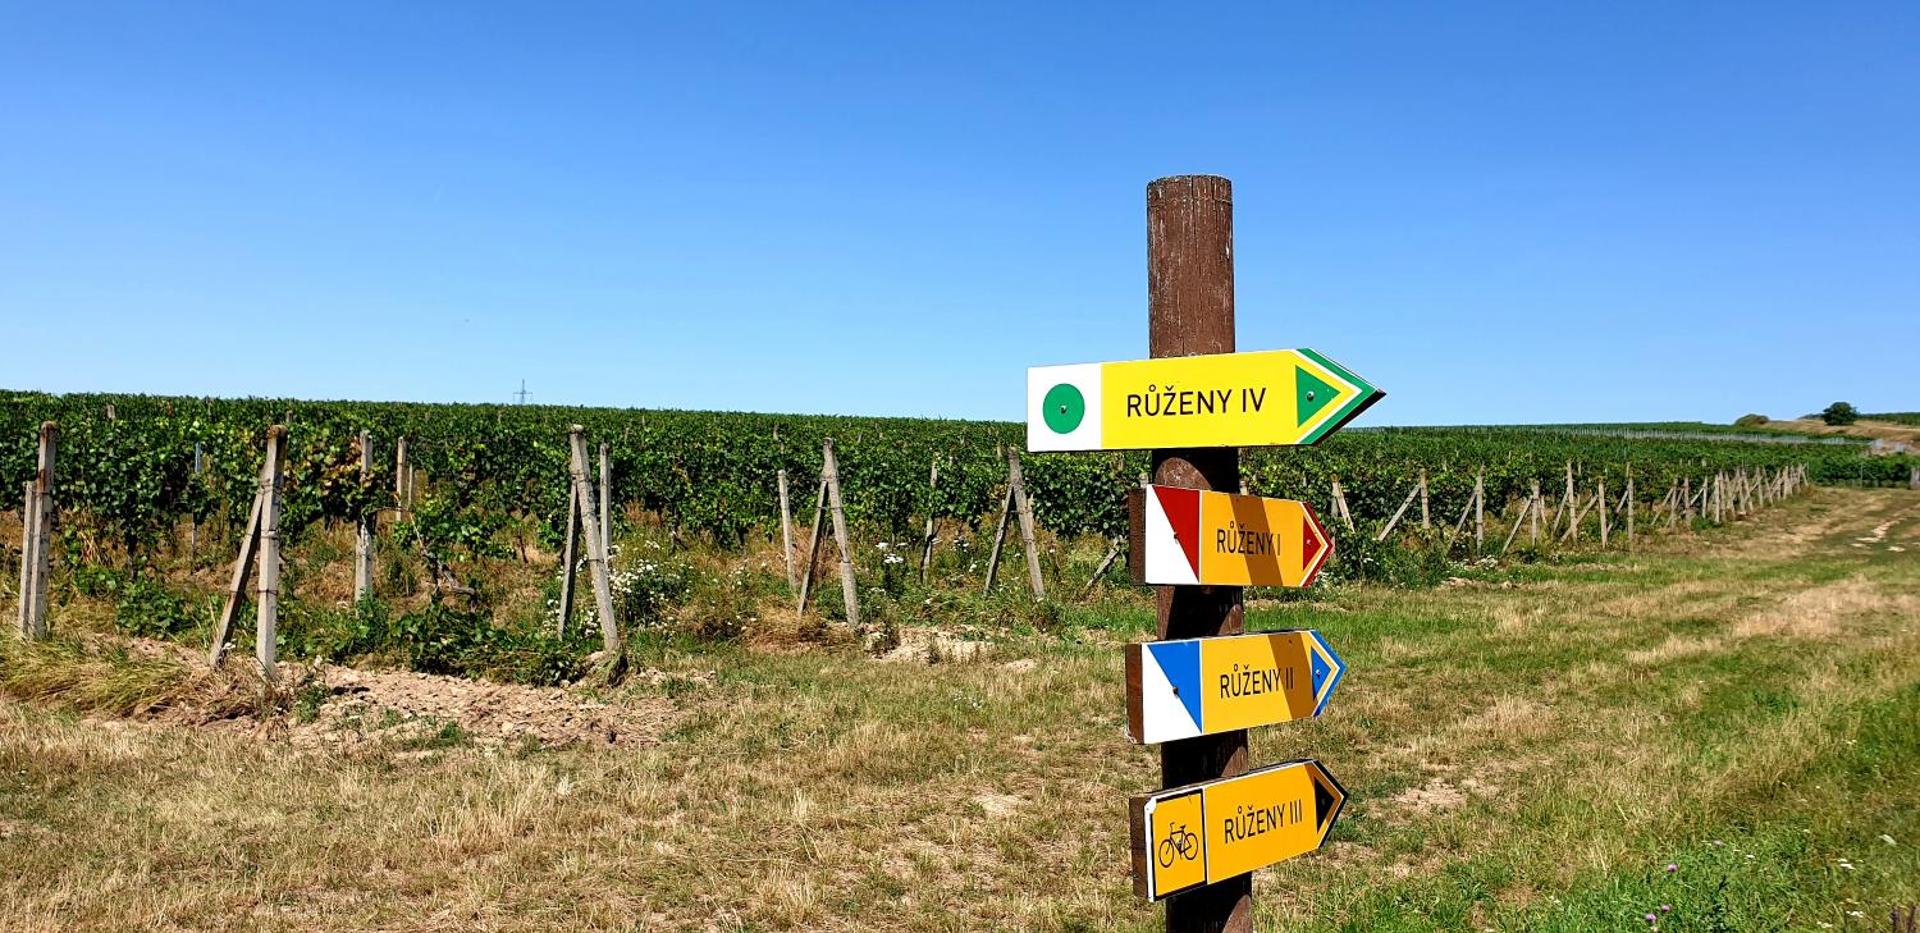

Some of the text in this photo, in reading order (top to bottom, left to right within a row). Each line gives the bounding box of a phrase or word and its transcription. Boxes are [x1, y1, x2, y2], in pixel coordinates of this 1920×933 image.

[1127, 383, 1267, 418] RŮŽENY IV
[1216, 520, 1281, 556] RŮŽENY I
[1220, 663, 1294, 699] RŮŽENY II
[1224, 799, 1303, 844] RŮŽENY III
